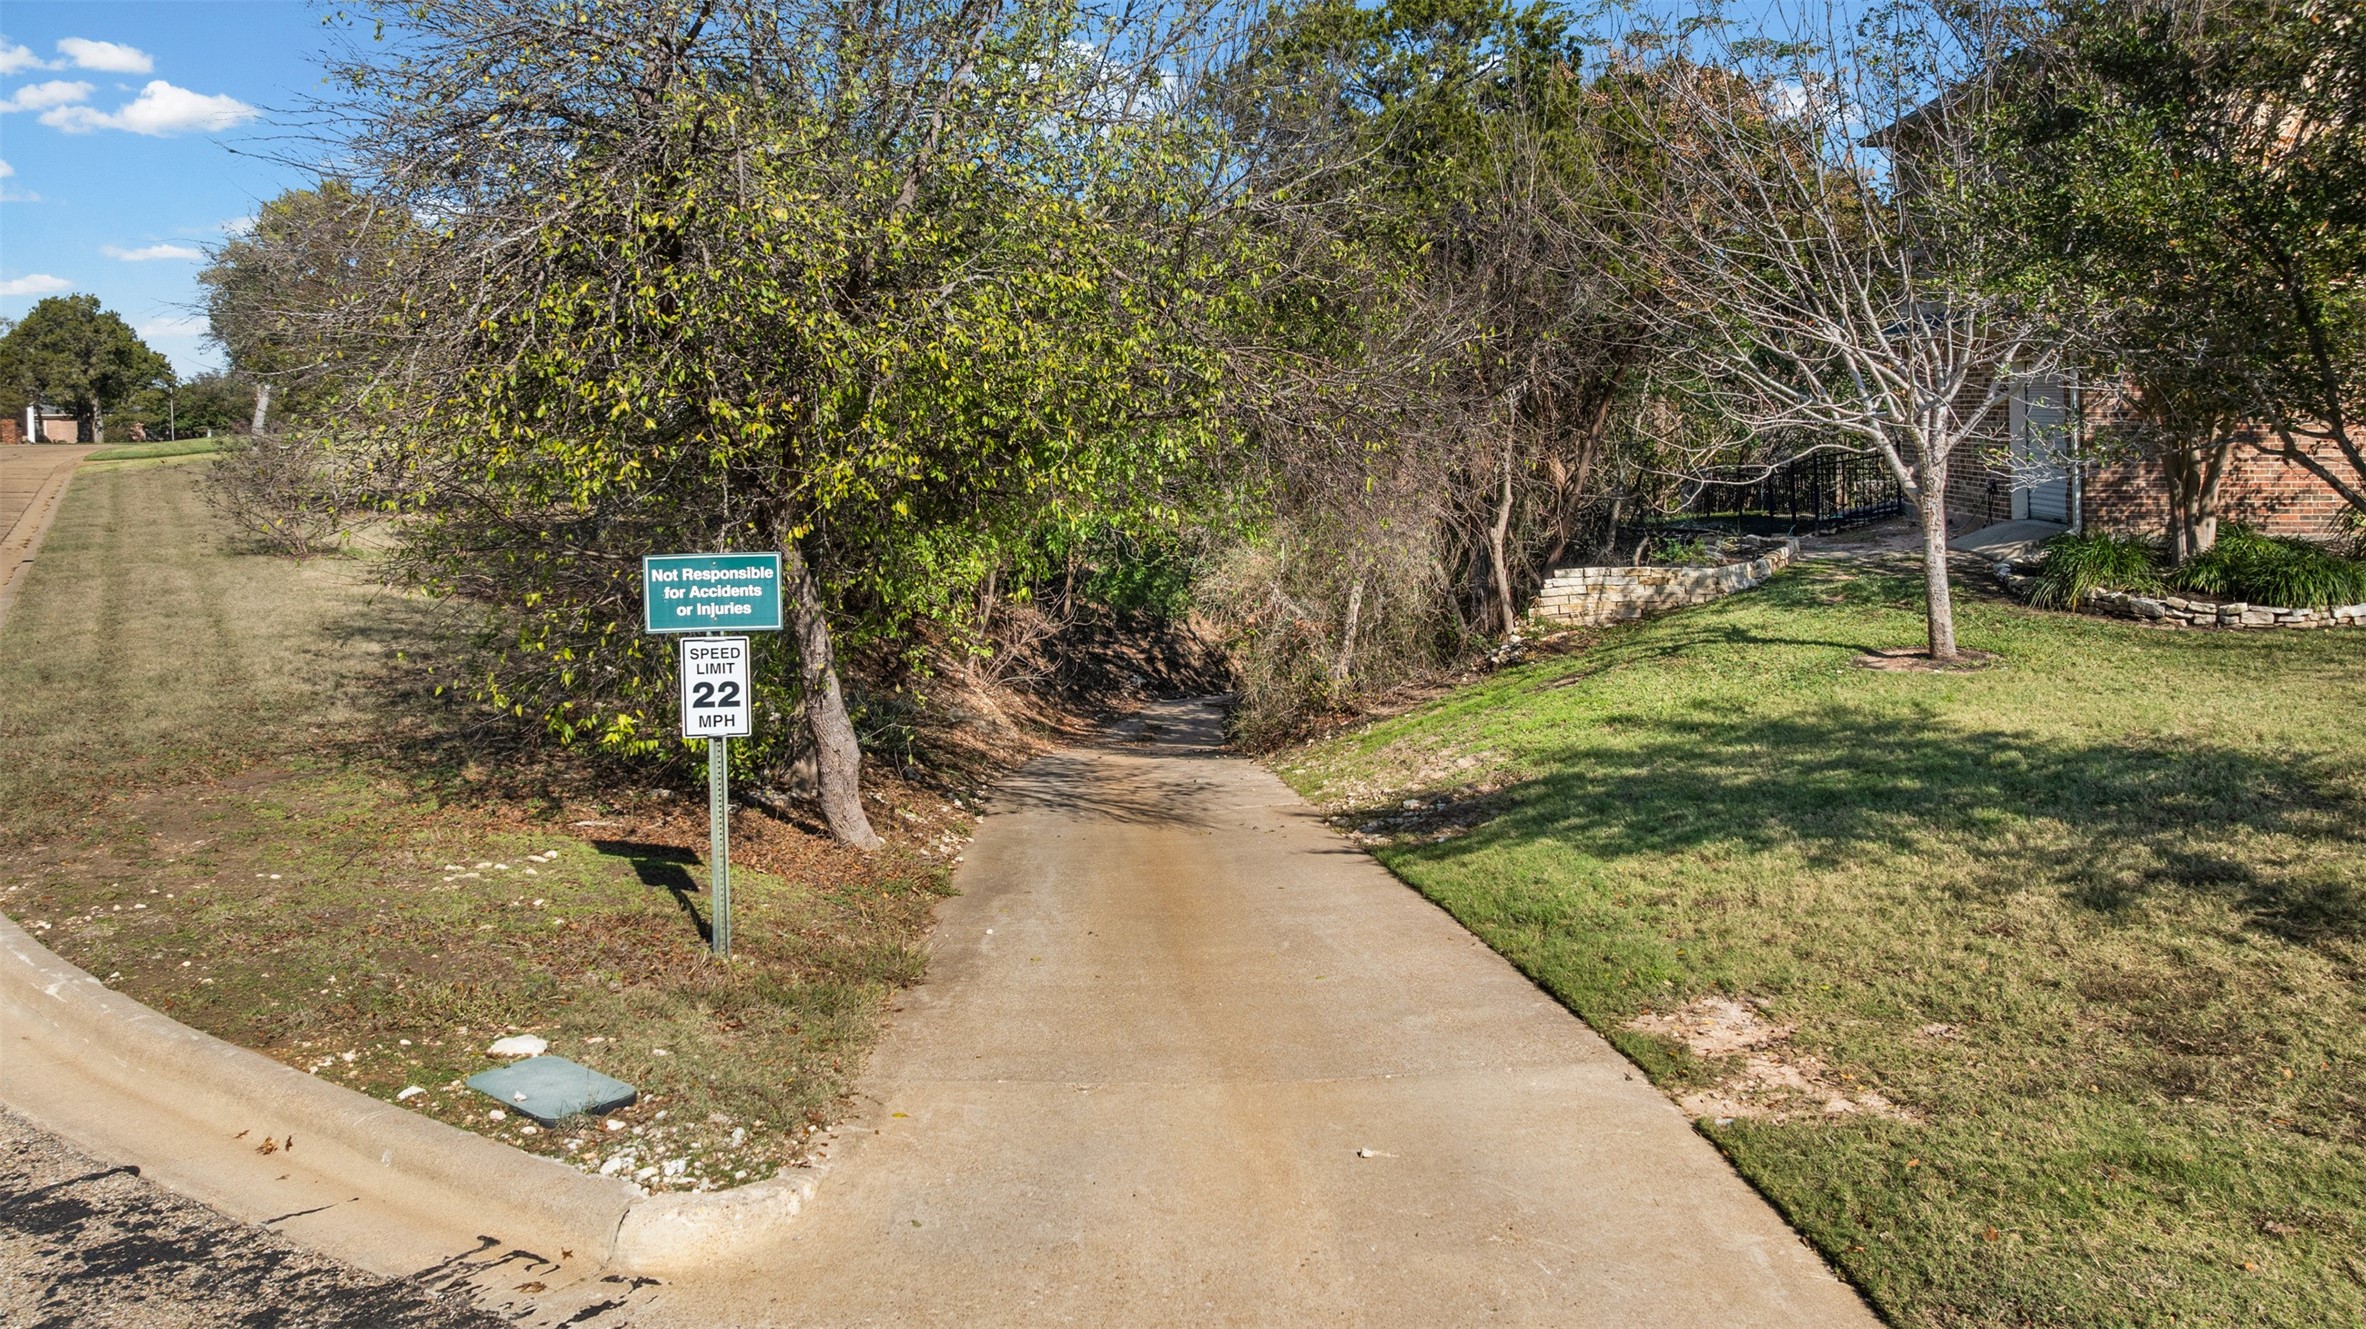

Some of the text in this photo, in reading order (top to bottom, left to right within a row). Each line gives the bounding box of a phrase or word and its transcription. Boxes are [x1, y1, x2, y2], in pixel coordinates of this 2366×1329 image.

[651, 566, 773, 583] Not Responsible
[664, 584, 762, 599] for Accidents
[676, 602, 752, 618] or Injuries
[690, 647, 741, 660] SPEED
[696, 662, 735, 675] LIMIT
[692, 681, 741, 709] 22
[698, 714, 735, 728] MPH
